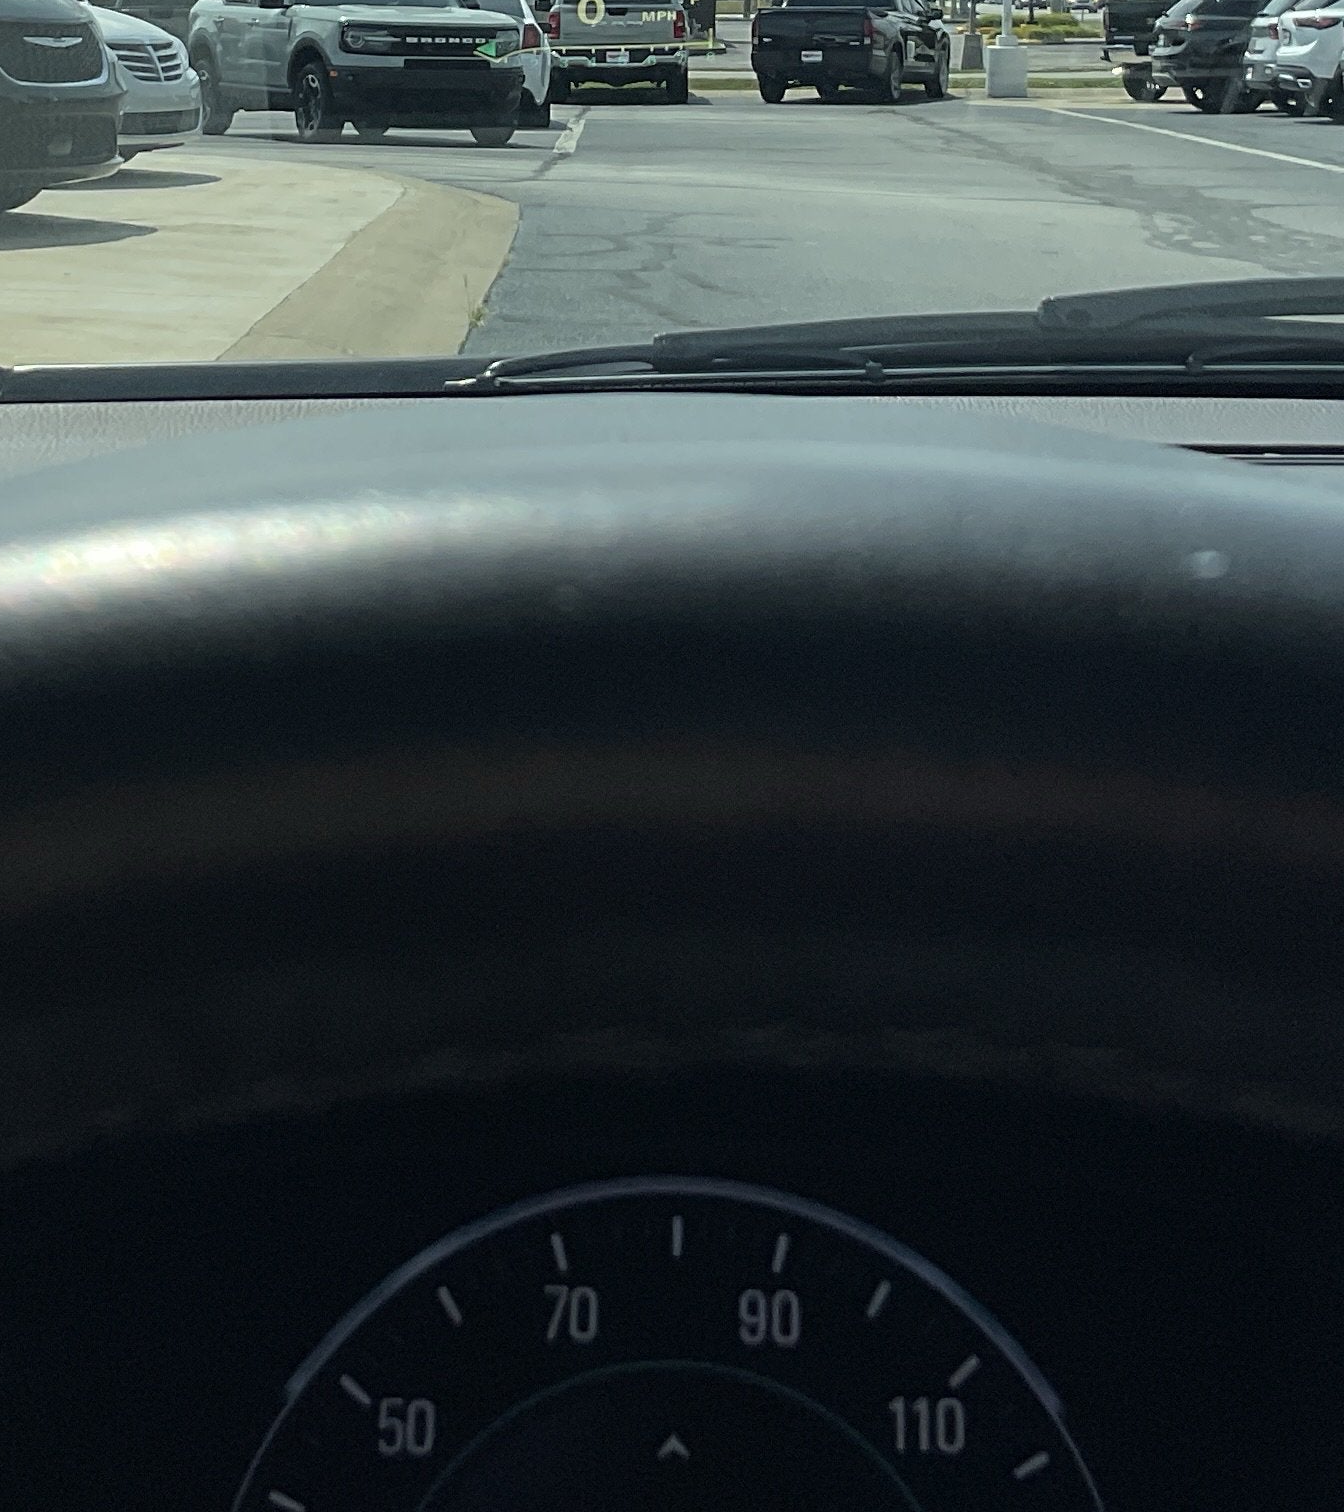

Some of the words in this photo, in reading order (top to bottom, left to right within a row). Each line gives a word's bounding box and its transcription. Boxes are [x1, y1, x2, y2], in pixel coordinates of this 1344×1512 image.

[642, 10, 677, 22] MPH
[405, 36, 486, 44] BRONCO
[544, 1285, 600, 1343] 70
[738, 1289, 801, 1346] 90
[377, 1397, 437, 1455] 50
[888, 1395, 966, 1453] 110
